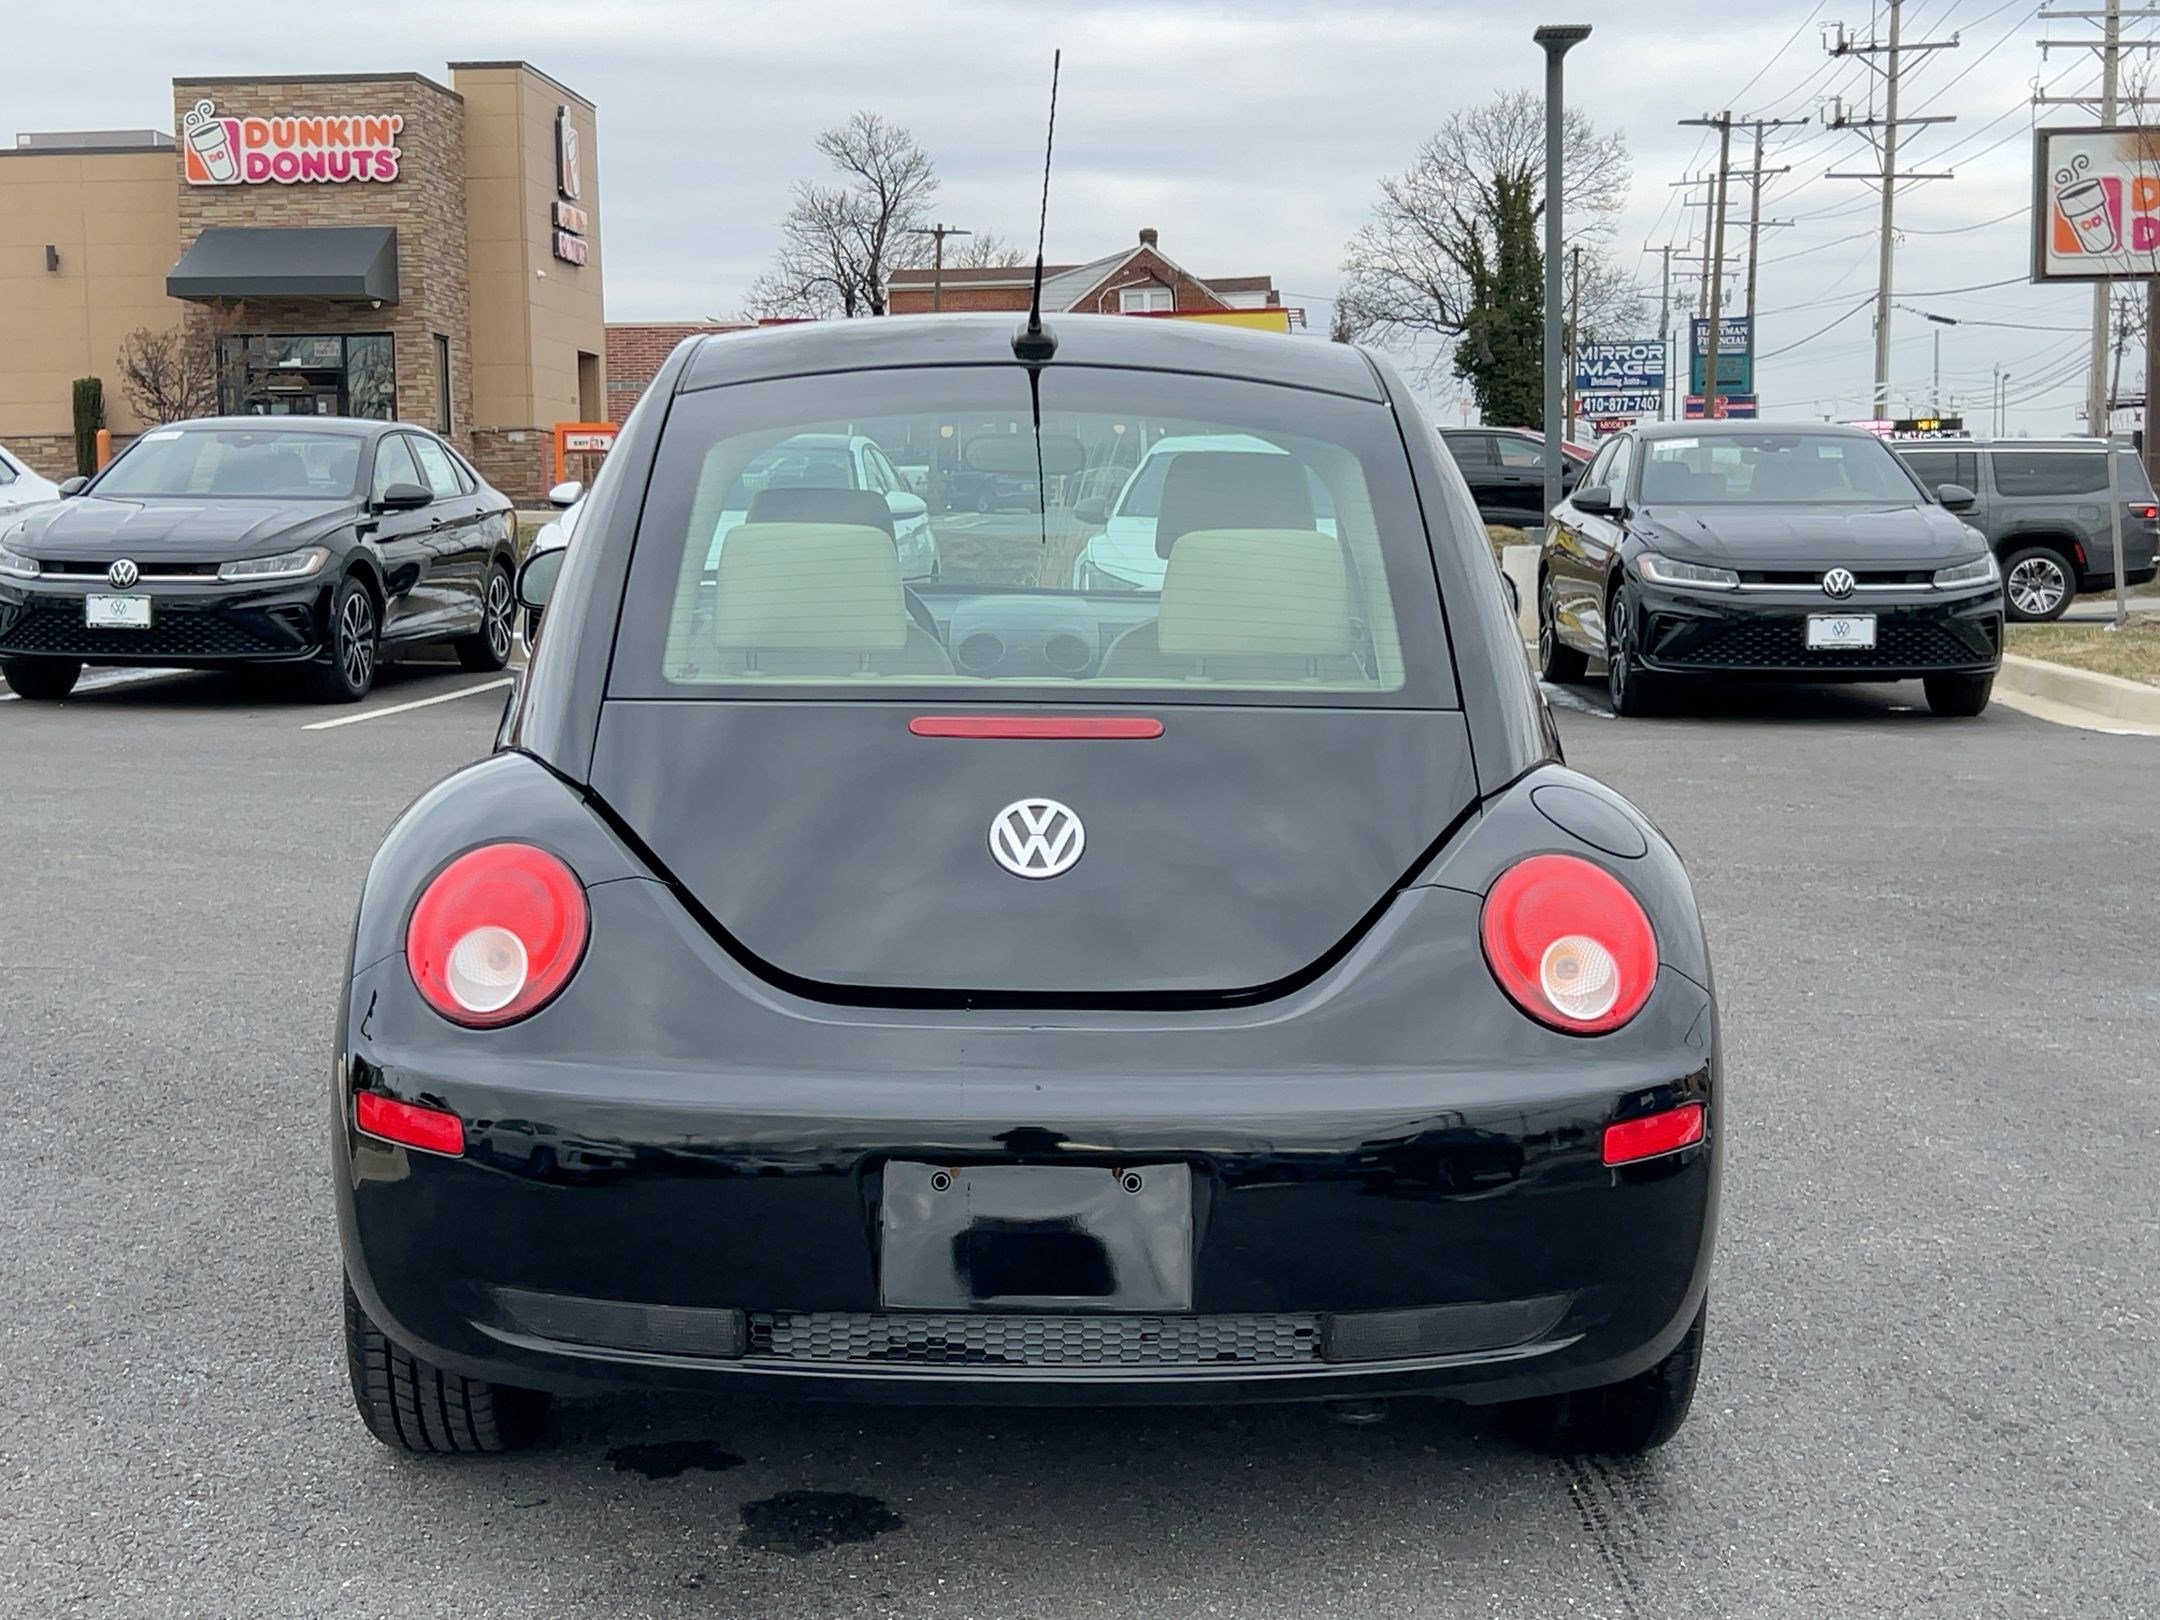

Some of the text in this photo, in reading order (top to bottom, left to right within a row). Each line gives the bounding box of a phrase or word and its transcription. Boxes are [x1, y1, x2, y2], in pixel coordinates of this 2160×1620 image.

[244, 118, 400, 149] DUNKIN'
[246, 150, 395, 180] DONUTS
[1575, 345, 1664, 360] MIRROR
[1575, 360, 1664, 376] IMAGE
[1583, 396, 1661, 413] 410-877-7407
[989, 798, 1085, 878] VW
